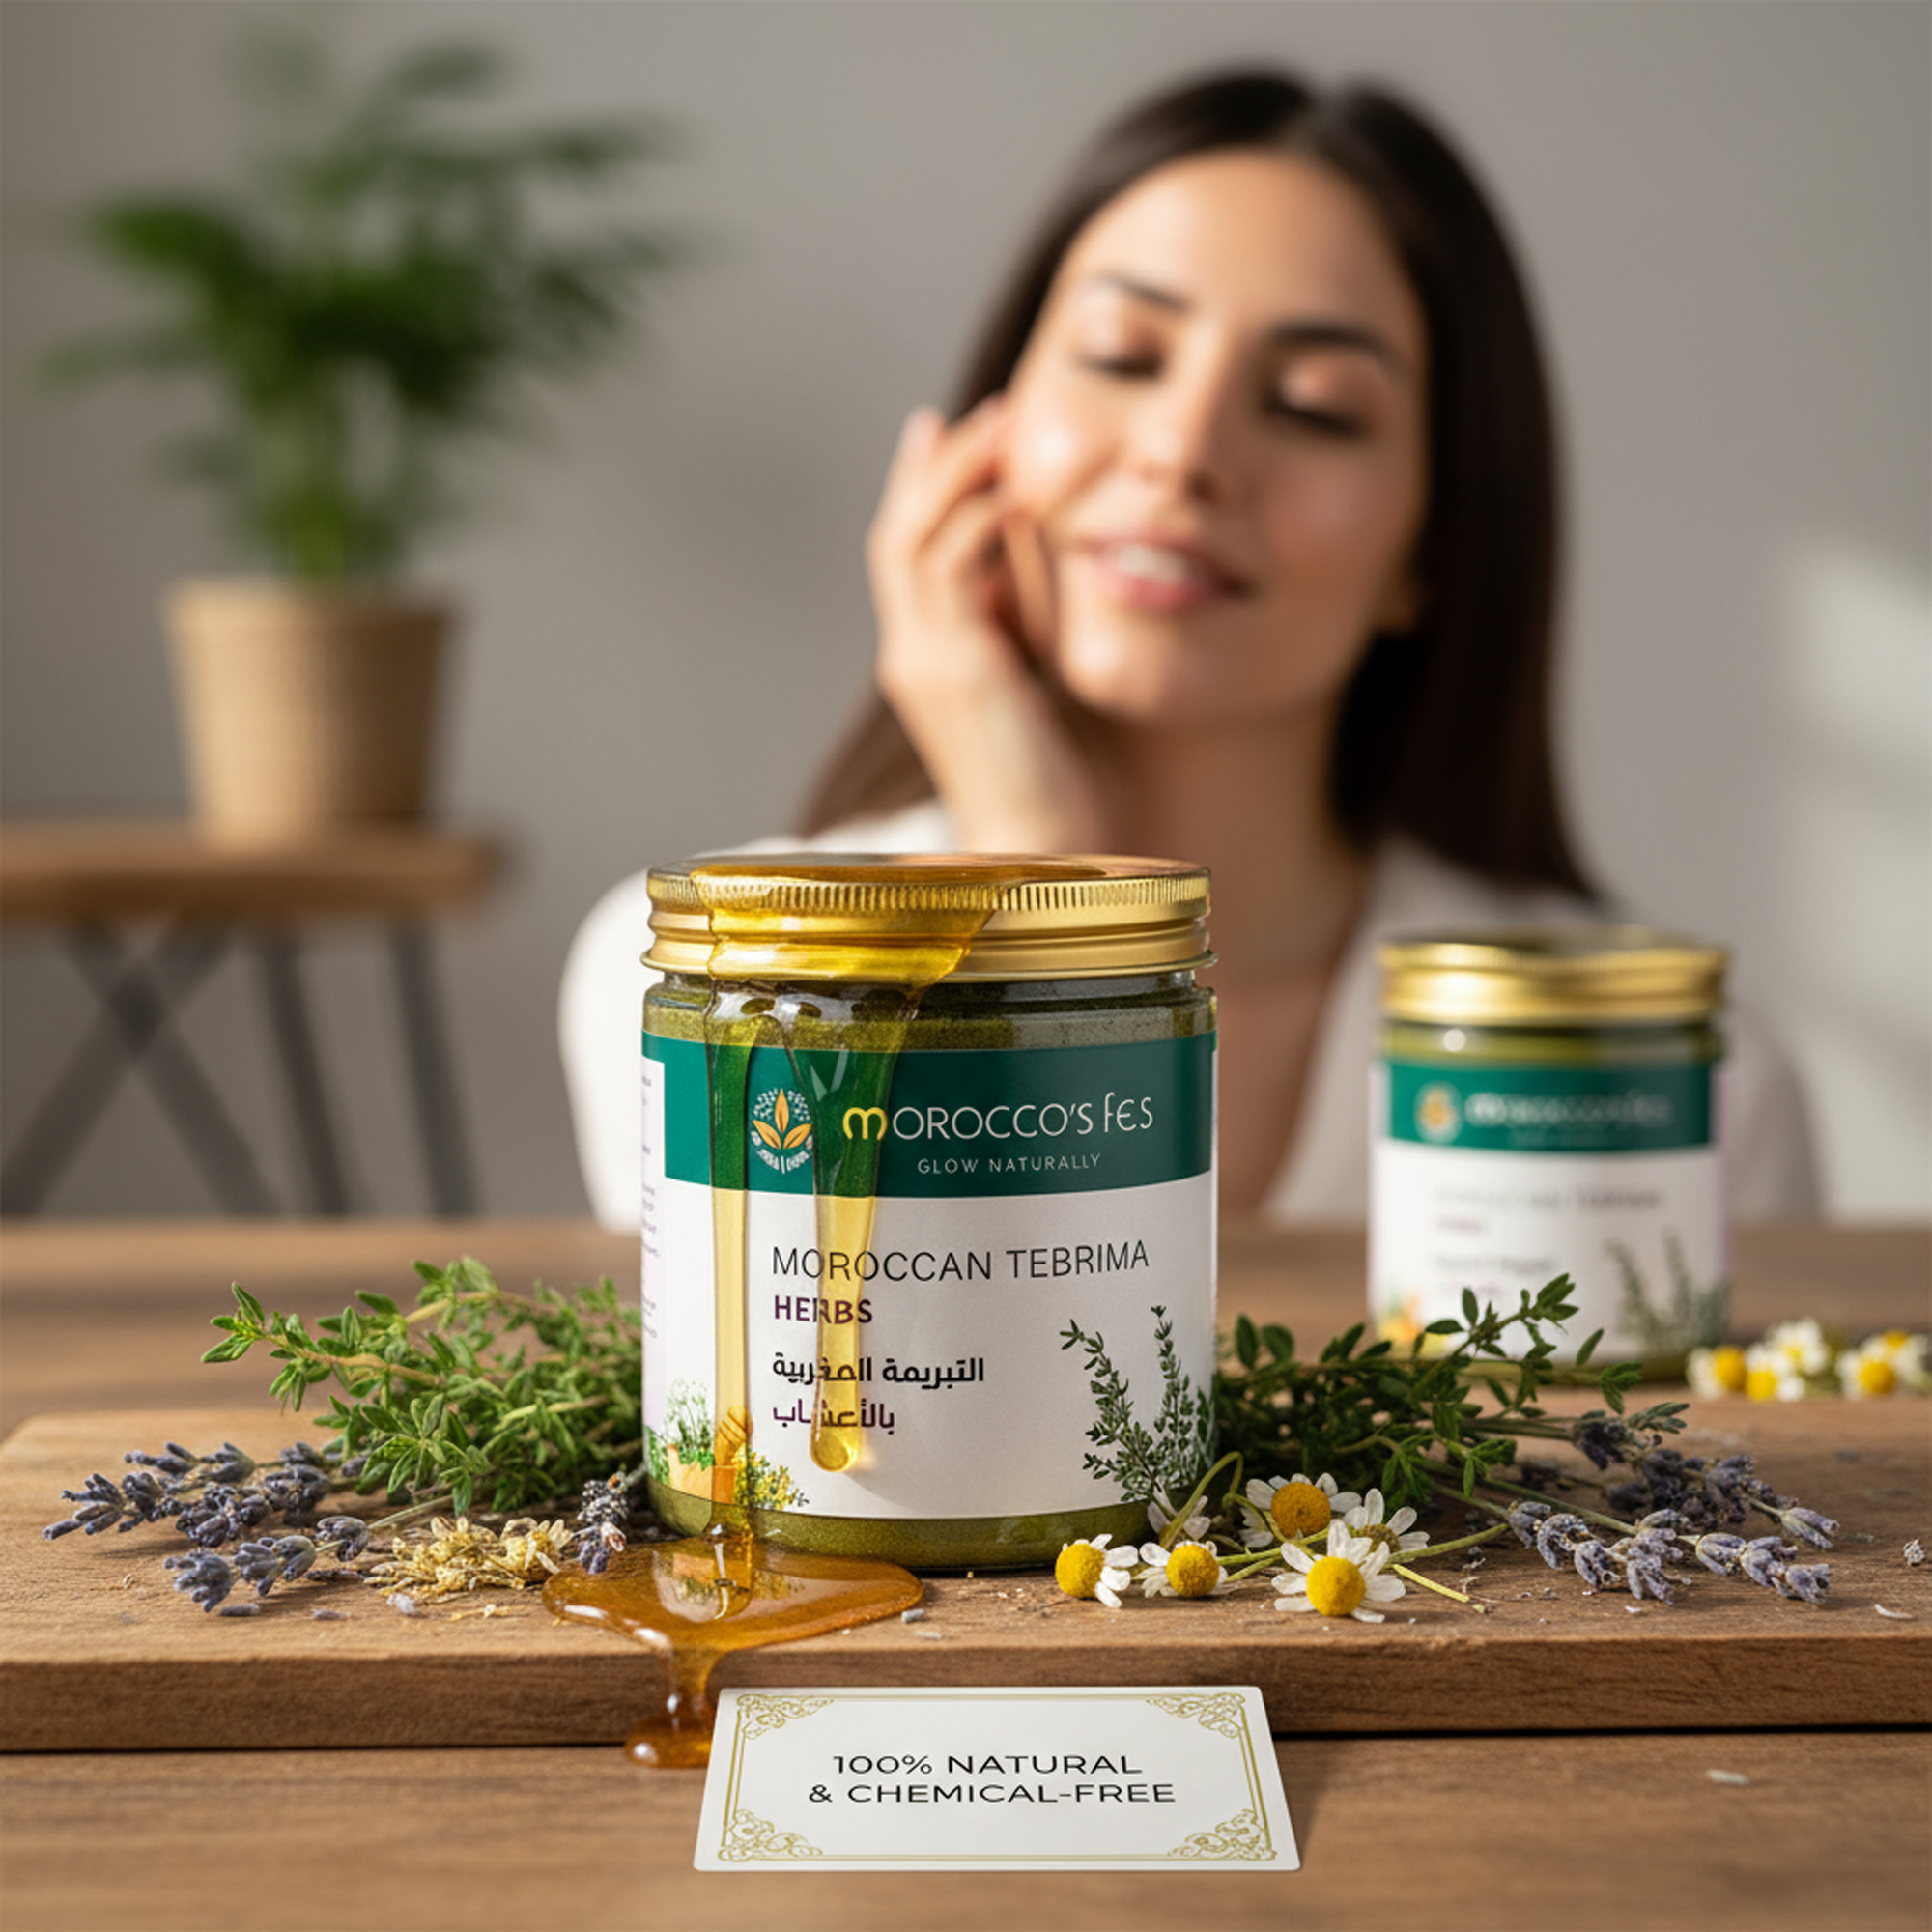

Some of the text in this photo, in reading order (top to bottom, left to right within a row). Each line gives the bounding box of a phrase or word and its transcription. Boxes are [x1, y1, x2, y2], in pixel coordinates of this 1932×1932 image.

[918, 1152, 1101, 1175] GLOW NATURALLY
[773, 1239, 1150, 1282] MOROCCAN TEBRIMA
[775, 1295, 873, 1324] HERBS
[772, 1352, 984, 1390] التبريمة المغربية
[833, 1755, 1143, 1775] 100% NATURAL
[808, 1783, 1176, 1803] & CHEMICAL-FREE
